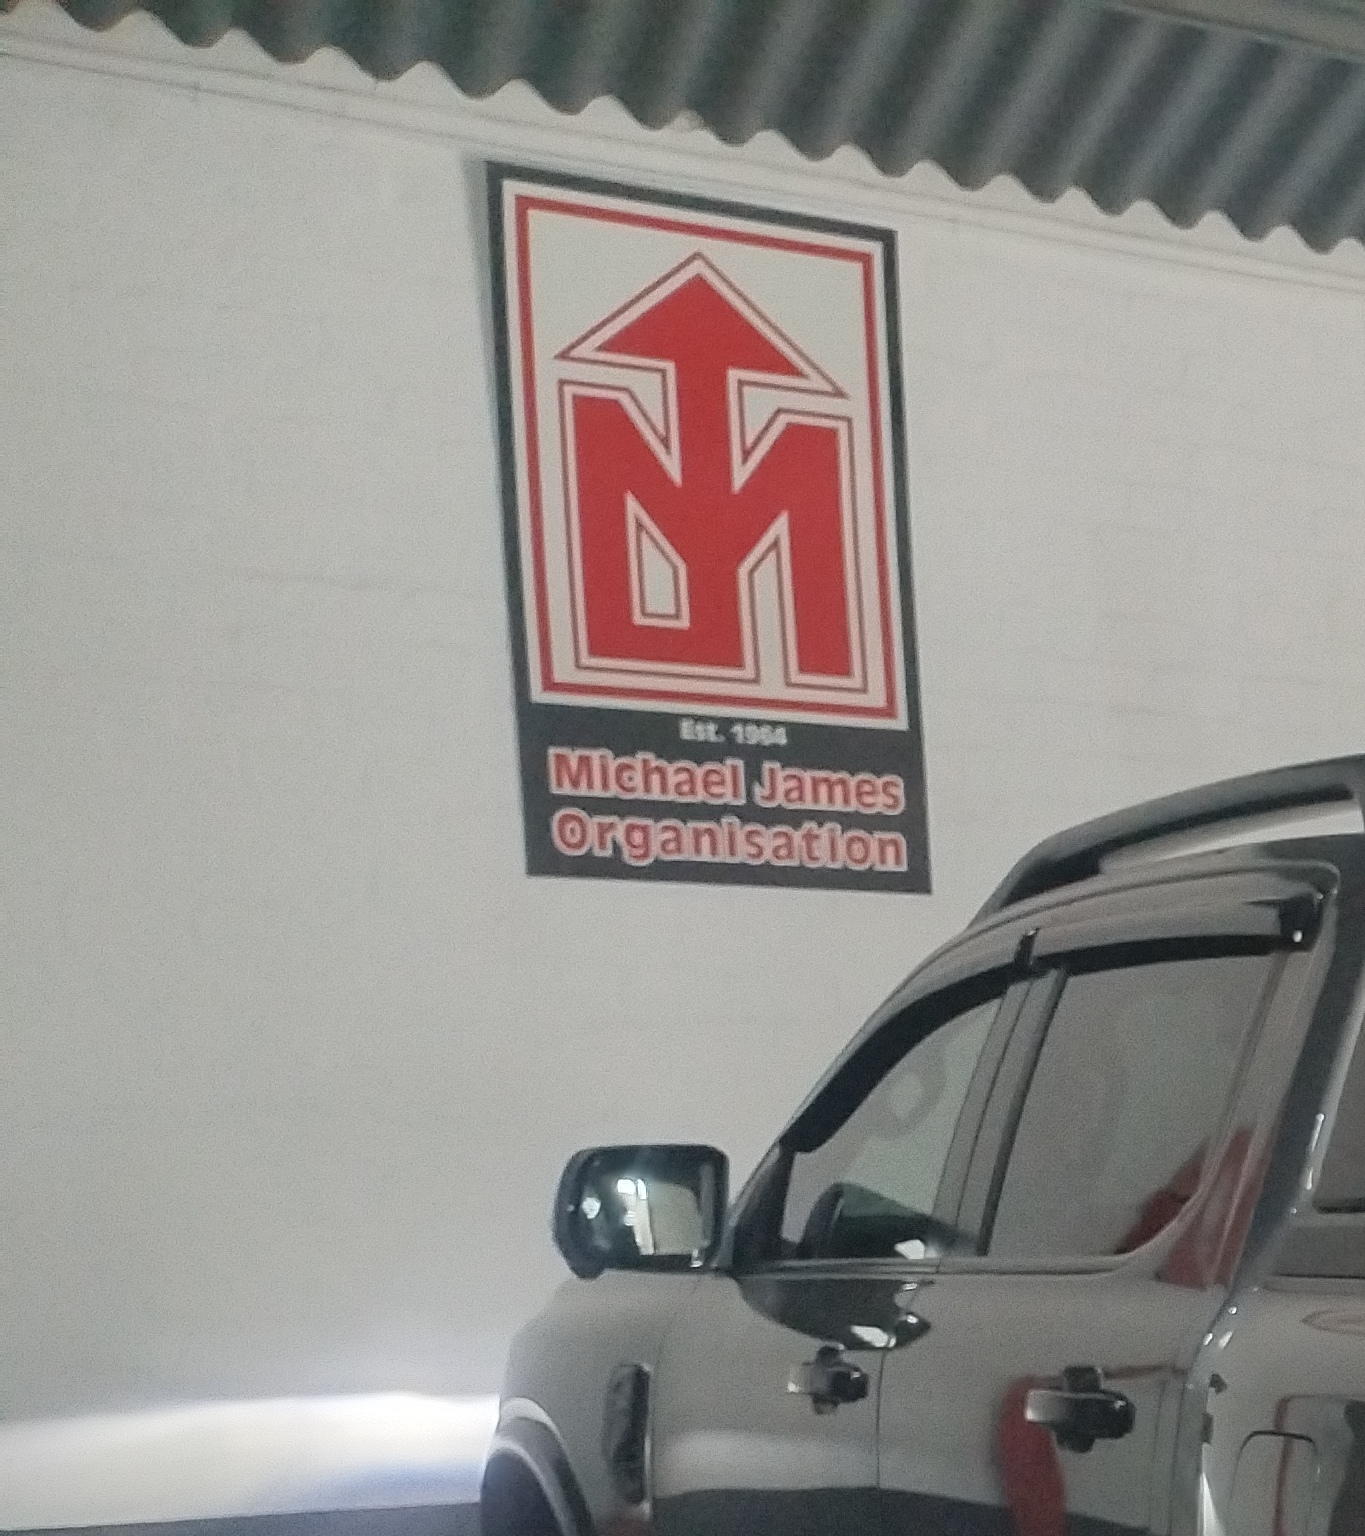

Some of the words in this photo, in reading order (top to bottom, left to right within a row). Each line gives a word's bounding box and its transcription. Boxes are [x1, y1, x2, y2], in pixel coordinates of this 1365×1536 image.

[679, 718, 722, 743] Est.
[730, 722, 787, 746] 1964
[549, 746, 745, 804] Michael
[755, 761, 904, 814] James
[552, 807, 907, 871] Organisation
